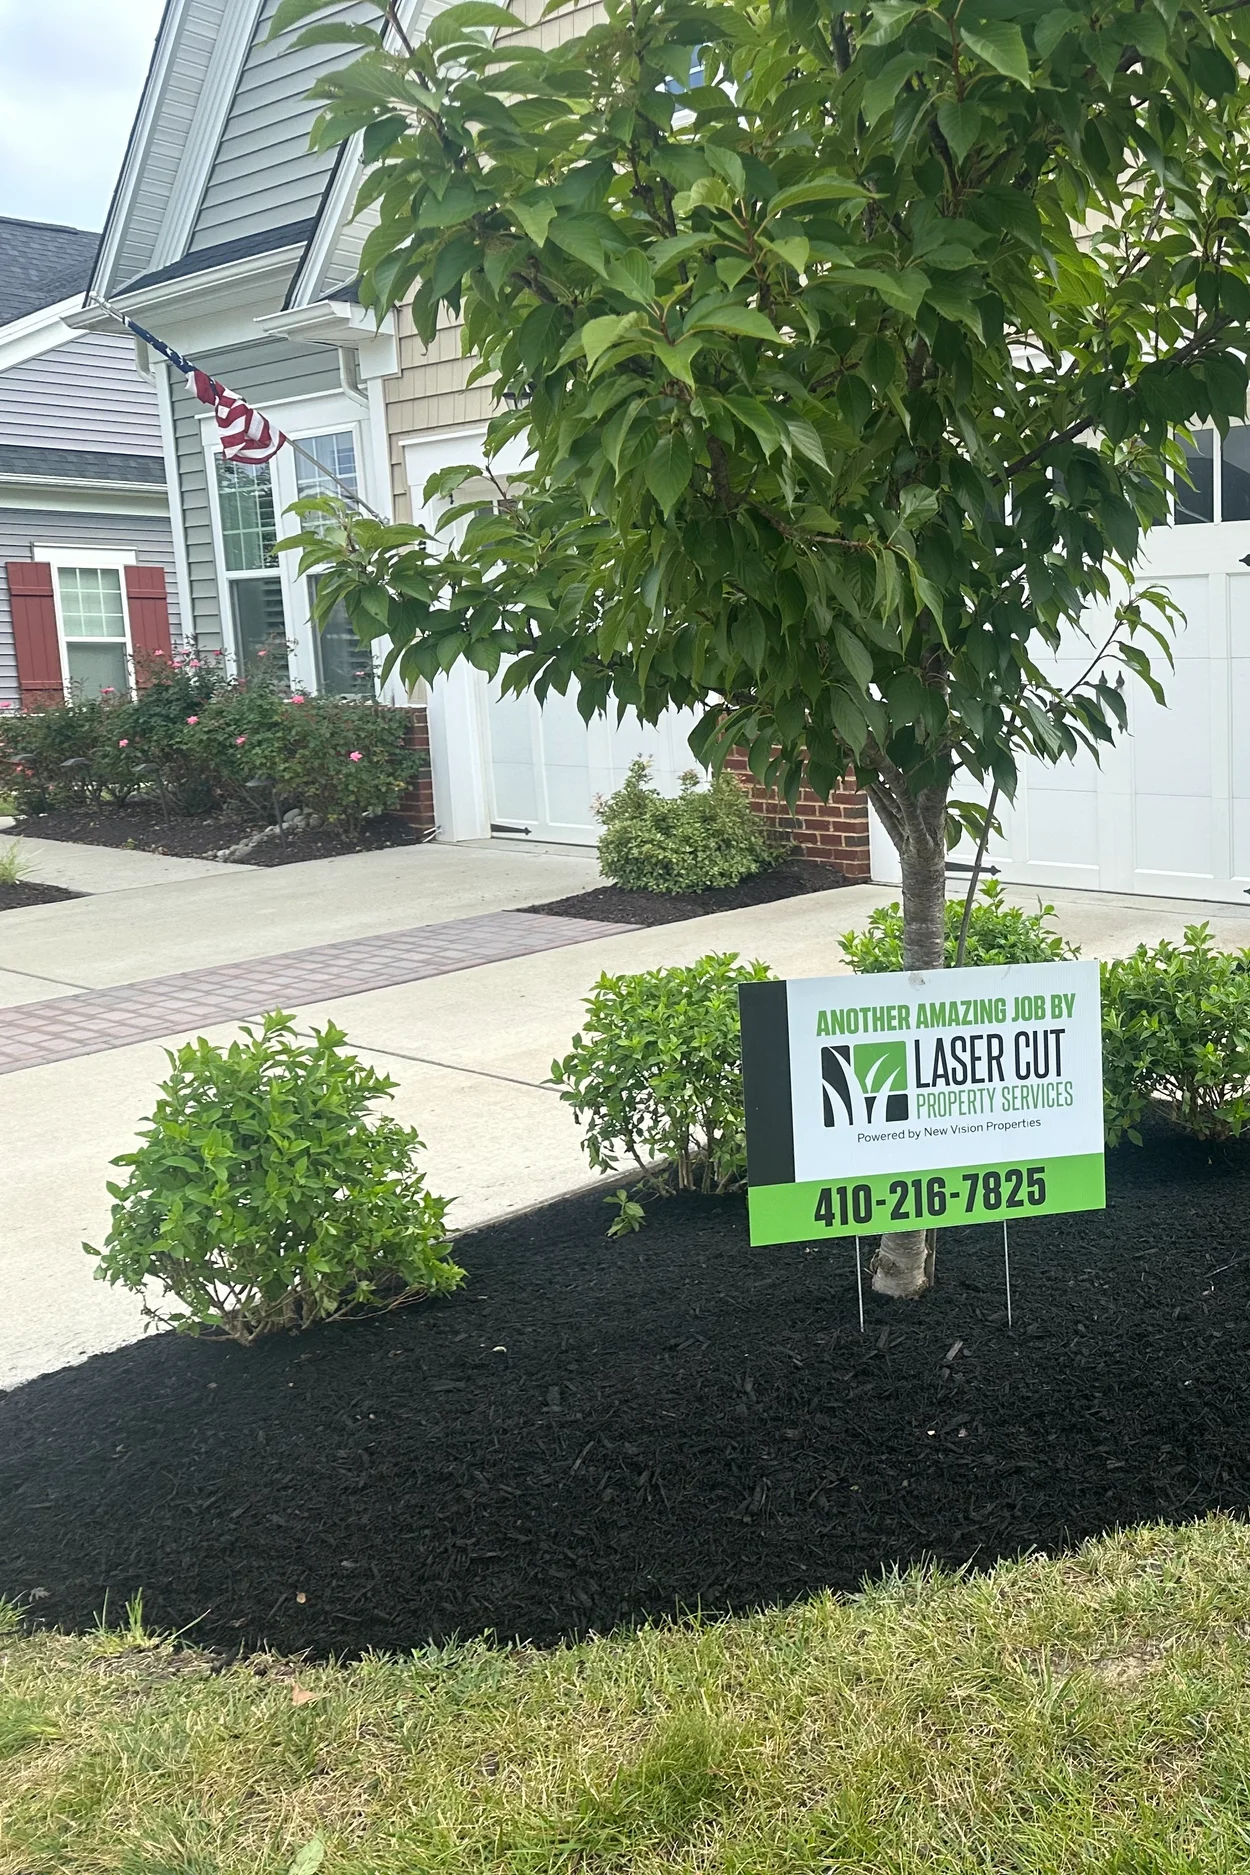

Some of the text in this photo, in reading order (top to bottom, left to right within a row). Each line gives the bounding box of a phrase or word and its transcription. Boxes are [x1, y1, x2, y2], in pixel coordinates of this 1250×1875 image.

[816, 992, 1076, 1037] ANOTHER AMAZING JOB BY
[914, 1028, 1066, 1089] LASER CUT
[916, 1080, 1074, 1120] PROPERTY SERVICES
[857, 1117, 1042, 1143] Powered by New Vision Properties
[814, 1166, 1047, 1228] 410-216-7825
